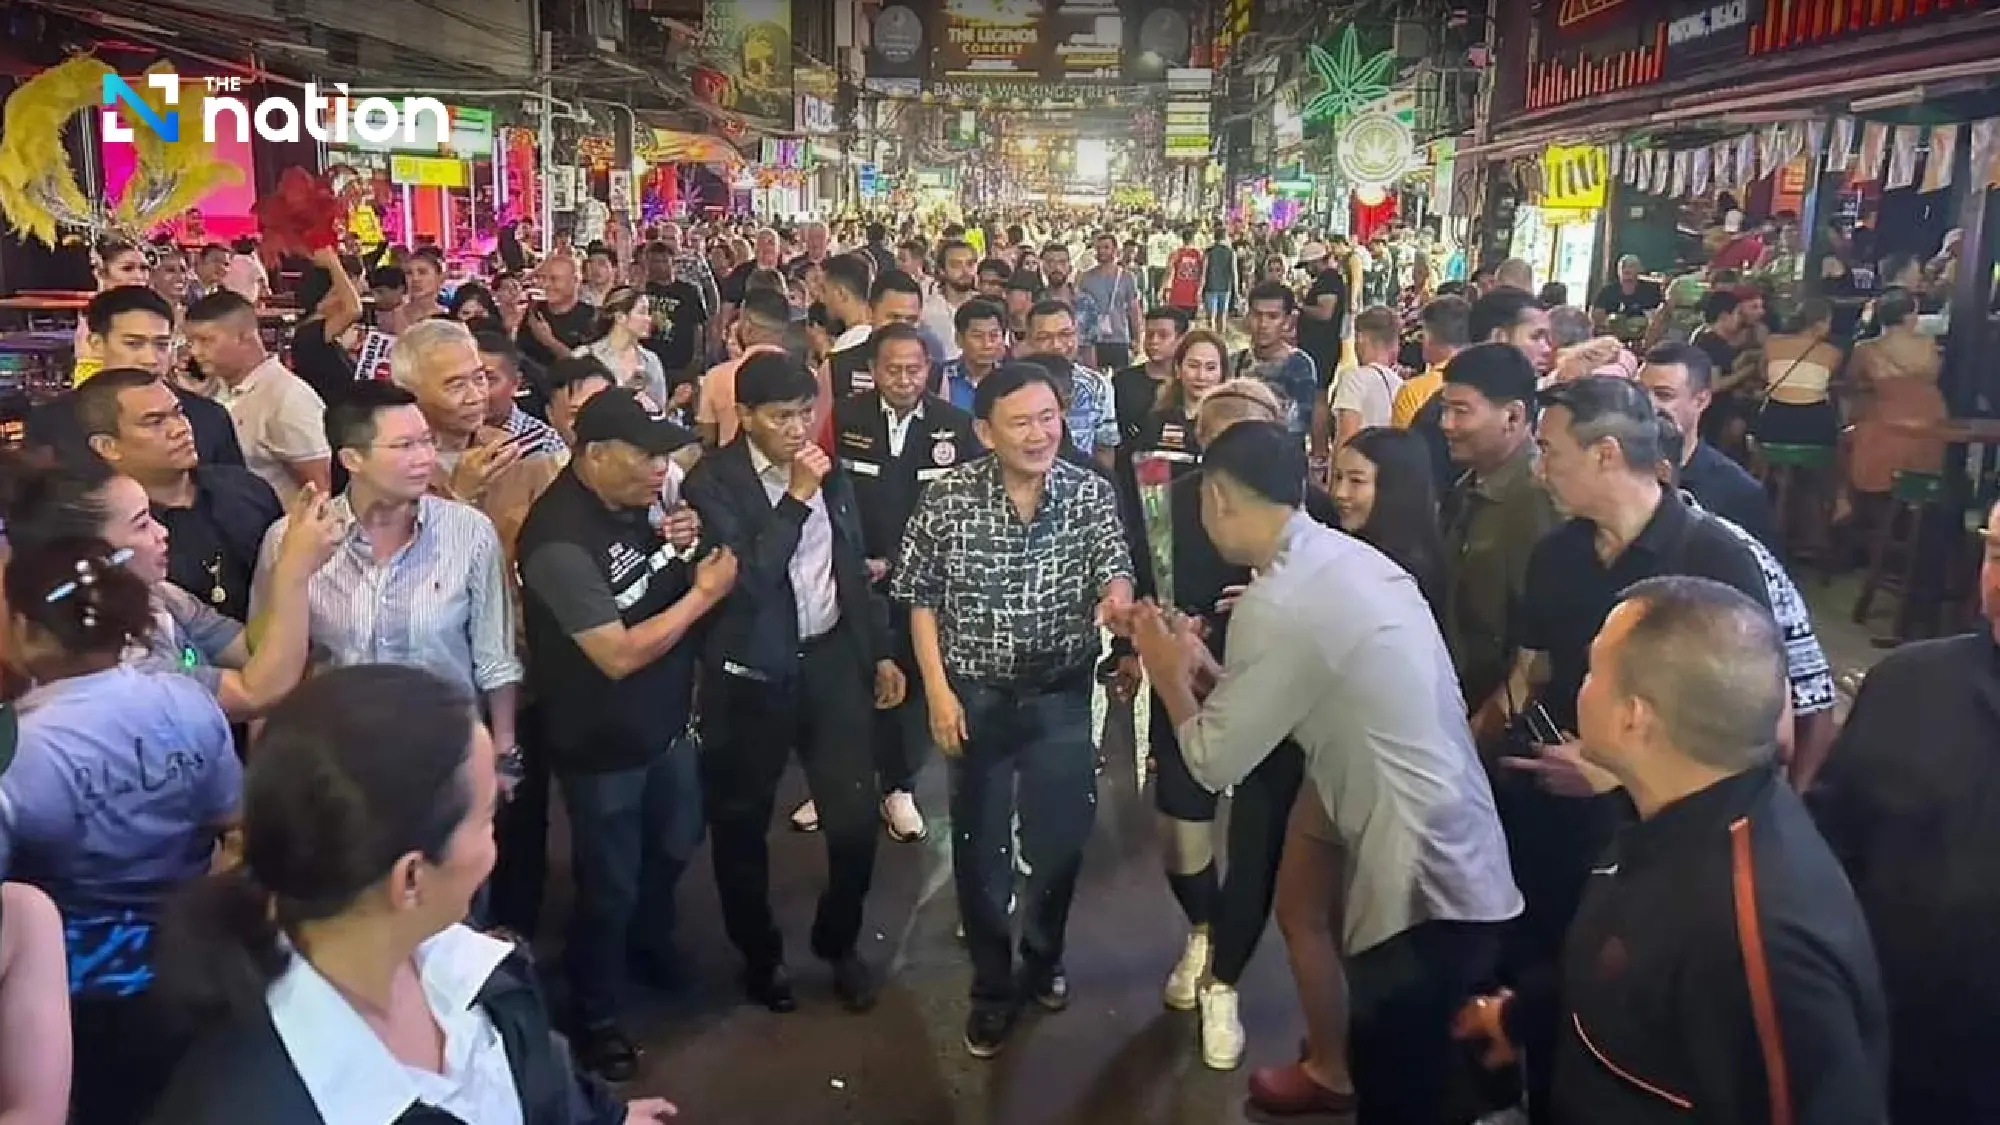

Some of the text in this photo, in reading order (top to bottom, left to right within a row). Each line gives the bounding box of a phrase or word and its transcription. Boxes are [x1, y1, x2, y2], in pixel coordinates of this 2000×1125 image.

[948, 27, 1038, 43] THE LEGENDS
[962, 43, 1023, 54] CONCERT
[934, 82, 992, 98] BANGLA
[997, 82, 1064, 98] WALKING
